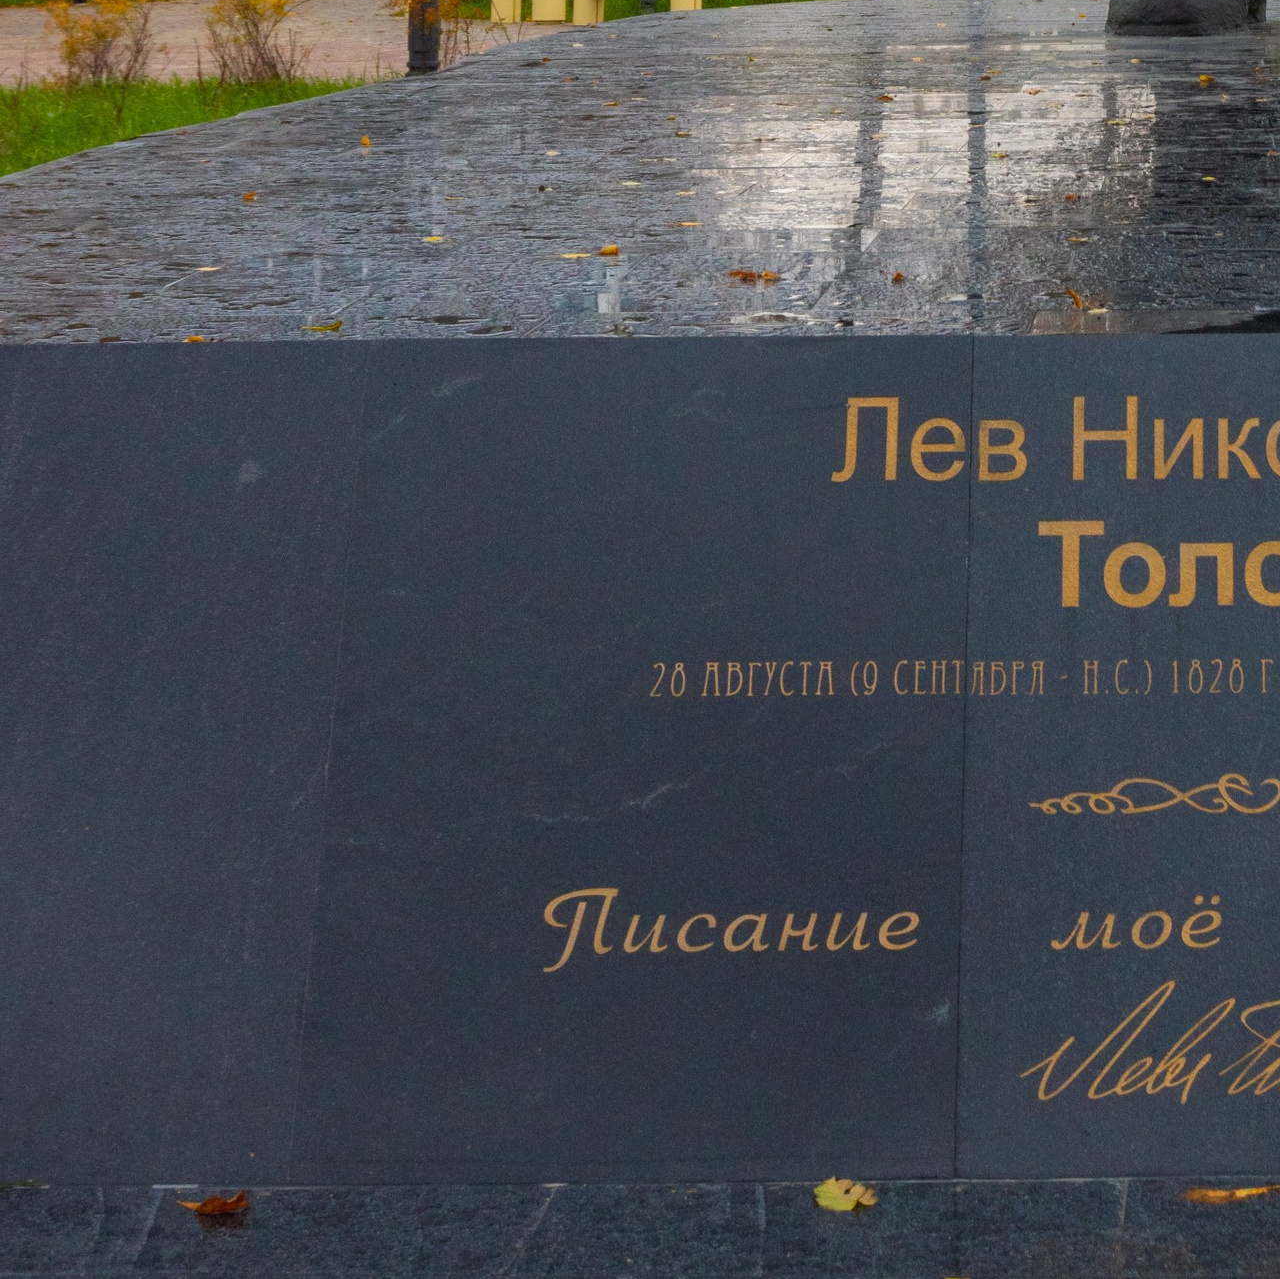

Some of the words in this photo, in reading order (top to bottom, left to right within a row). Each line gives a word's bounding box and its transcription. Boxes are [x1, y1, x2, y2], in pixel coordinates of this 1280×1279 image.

[831, 396, 1028, 483] Лев
[649, 662, 687, 698] 28
[701, 660, 835, 698] АВГУСТА
[850, 660, 879, 697] (9
[893, 659, 1045, 697] СЕНТЯБРЯ
[1083, 659, 1153, 695] Н.С.)
[1172, 658, 1245, 694] 1828
[543, 887, 920, 973] Писание
[1050, 895, 1223, 950] моё
